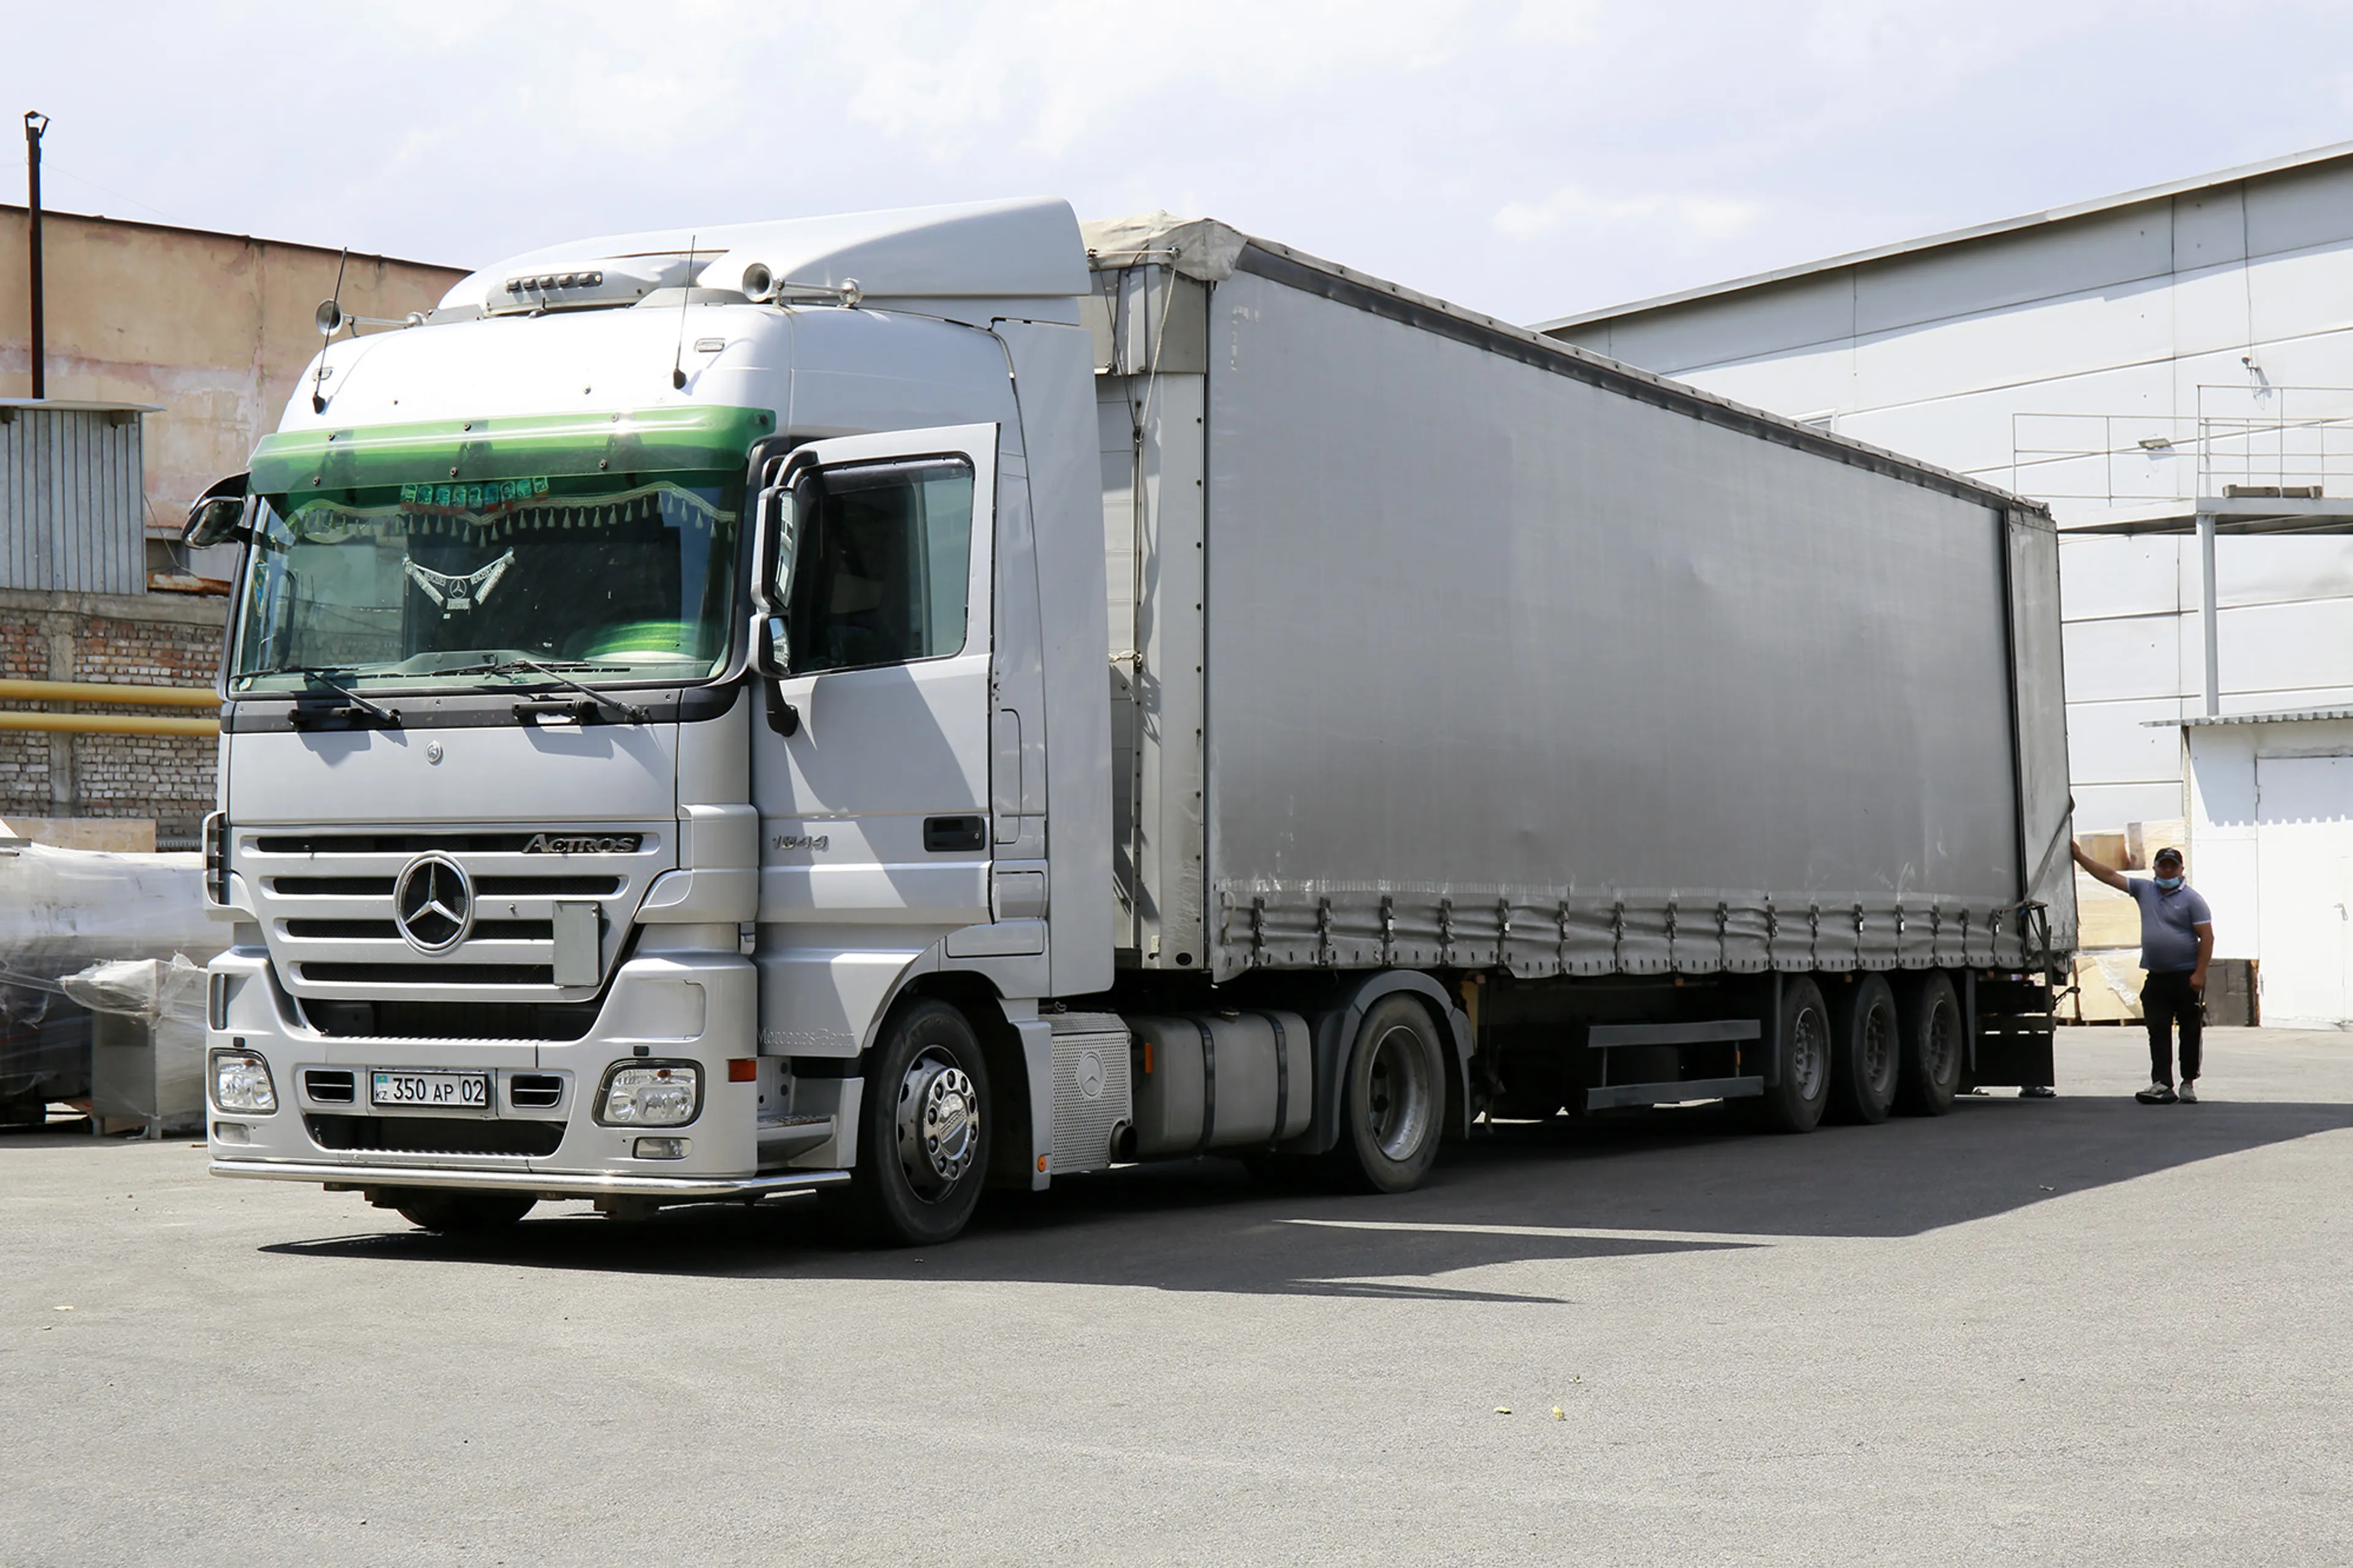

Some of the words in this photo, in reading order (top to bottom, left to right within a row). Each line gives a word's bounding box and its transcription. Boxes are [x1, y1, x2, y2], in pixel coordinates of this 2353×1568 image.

[376, 1090, 387, 1100] KZ
[393, 1078, 426, 1100] 350
[433, 1083, 454, 1101] AP
[462, 1079, 485, 1102] 02
